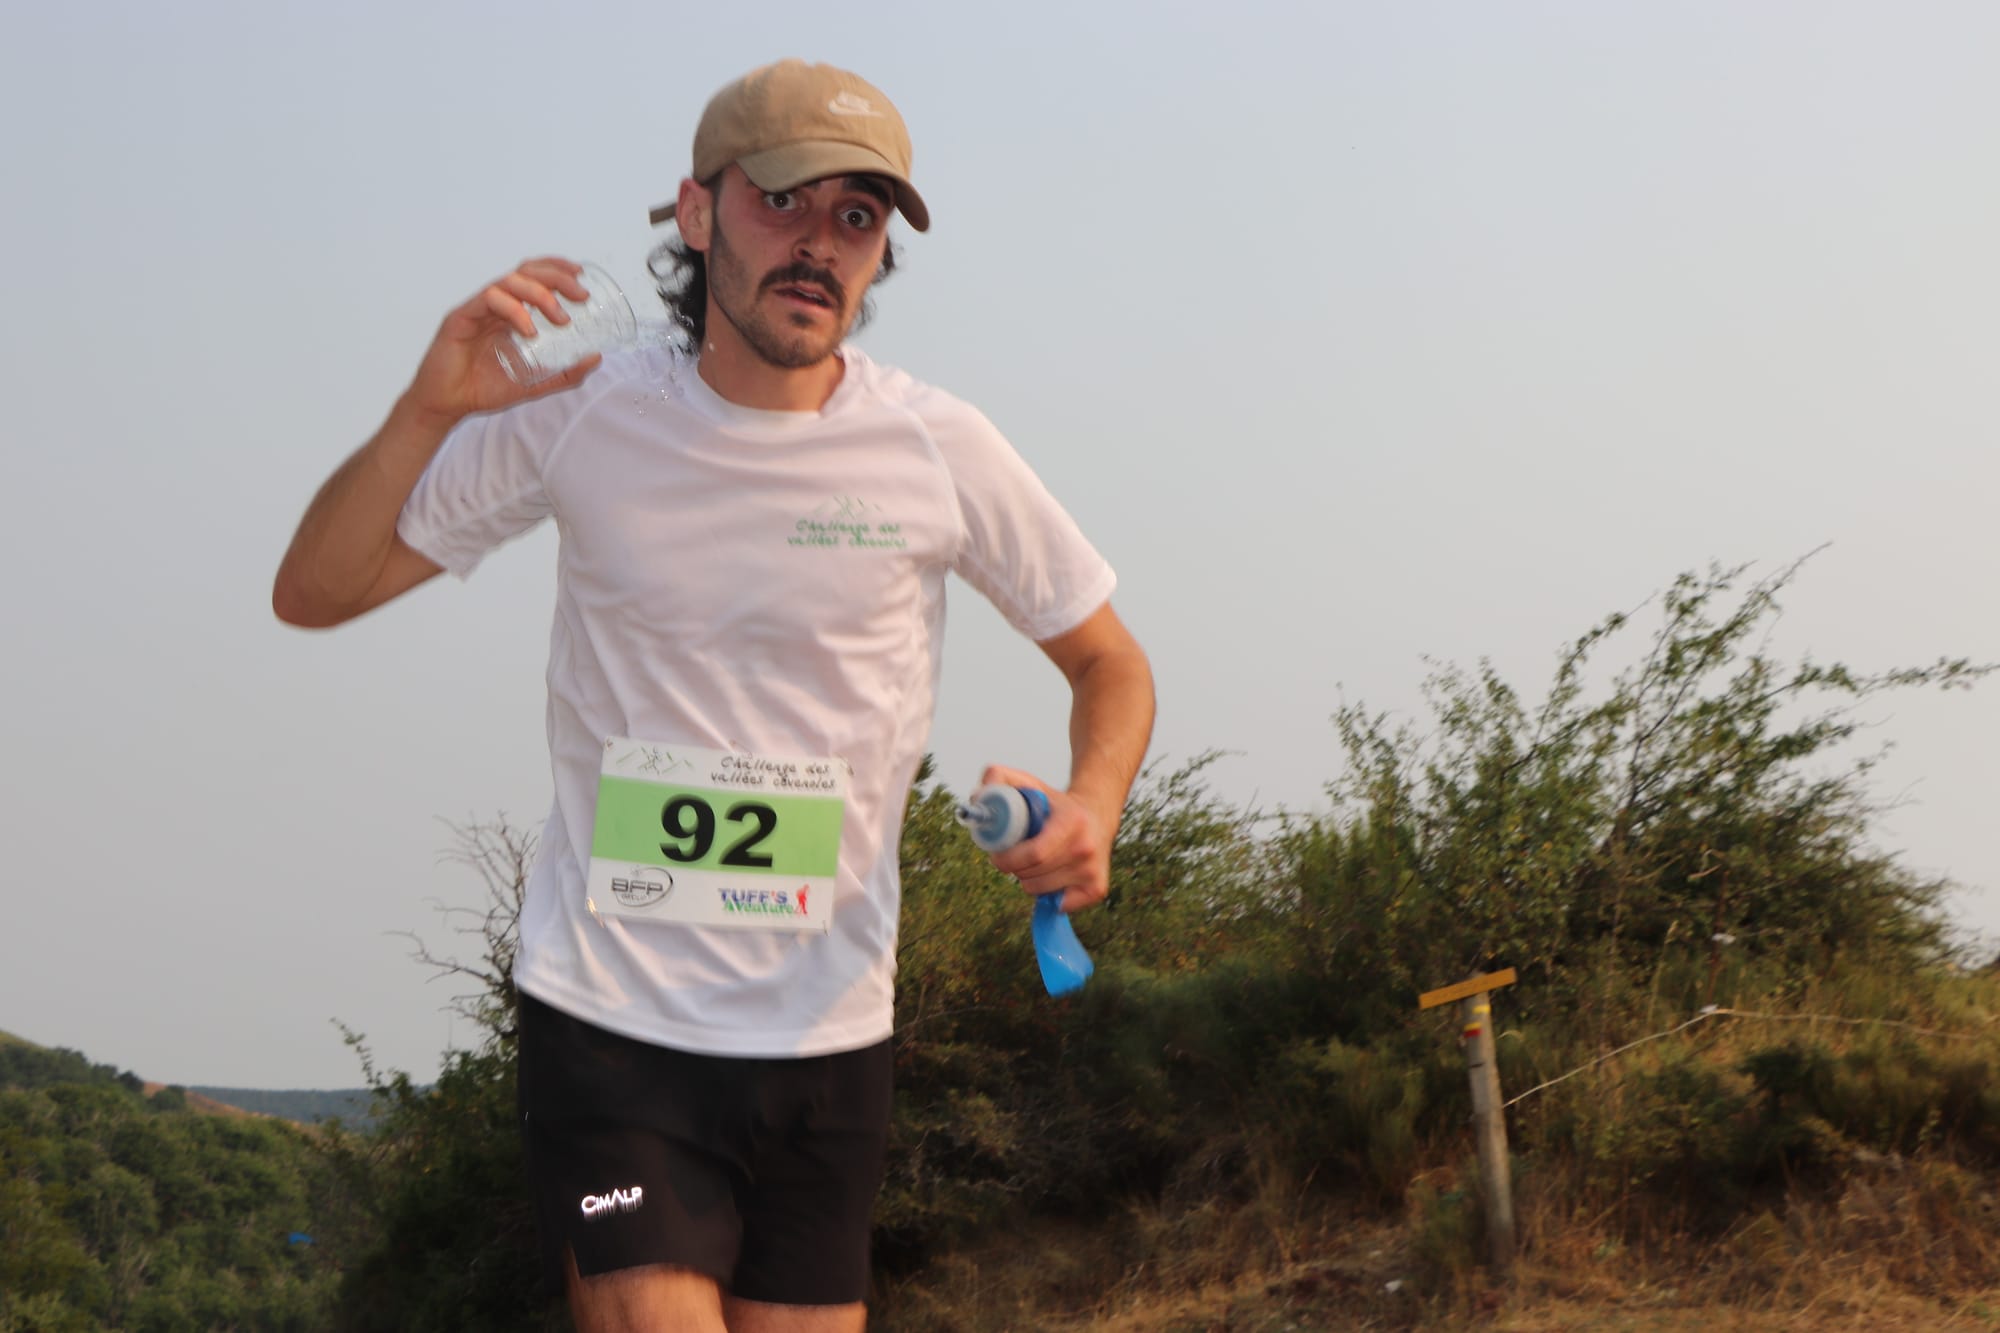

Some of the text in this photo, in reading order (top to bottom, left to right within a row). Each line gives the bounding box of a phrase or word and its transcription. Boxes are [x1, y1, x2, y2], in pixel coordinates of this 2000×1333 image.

[720, 756, 829, 776] Challenge des
[711, 770, 765, 785] vallées
[659, 793, 777, 868] 92
[611, 878, 663, 895] BFP
[718, 887, 788, 904] TUFF'S
